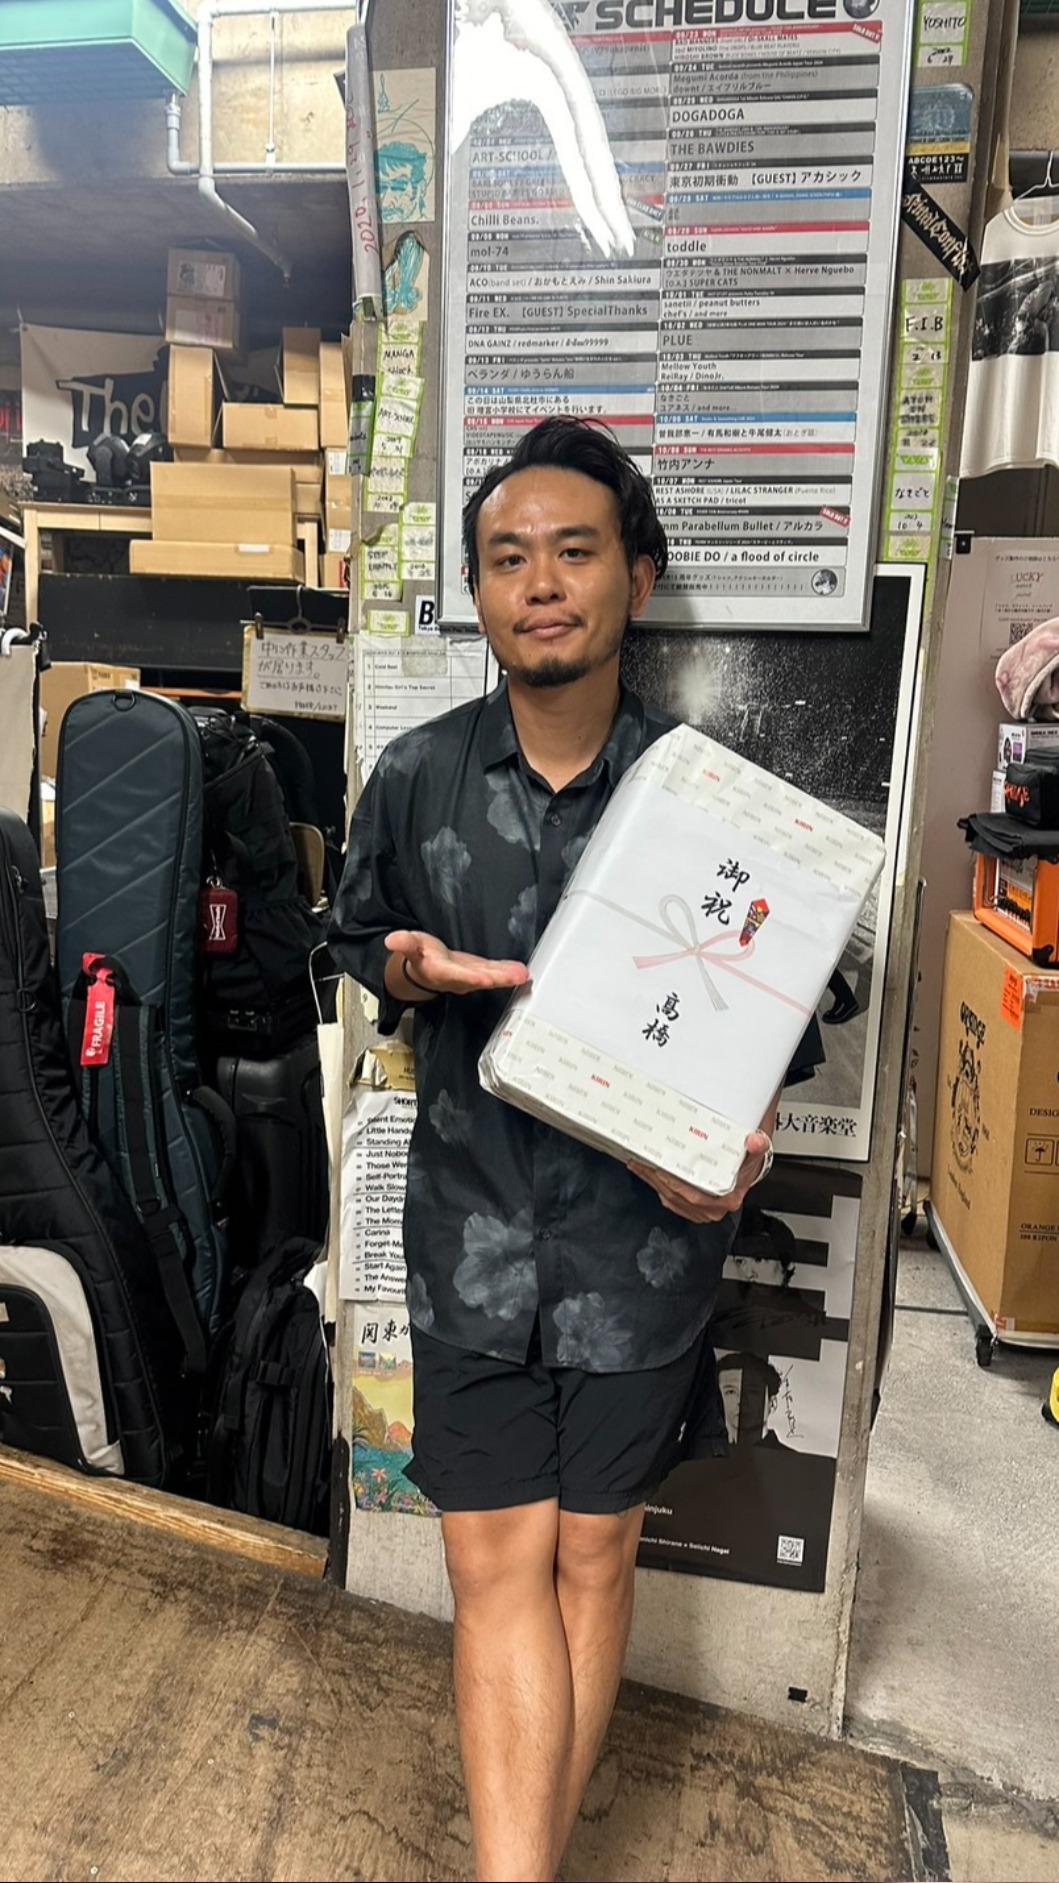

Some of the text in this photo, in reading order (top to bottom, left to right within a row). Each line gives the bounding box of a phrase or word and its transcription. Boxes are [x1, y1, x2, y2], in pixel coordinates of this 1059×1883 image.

[595, 0, 836, 30] SCHEDULE
[923, 15, 967, 31] YOSHITO
[673, 73, 707, 84] Megumi
[709, 71, 739, 81] Acorda
[672, 108, 745, 122] DOGADOGA
[671, 141, 755, 156] THE BAWDIES
[801, 169, 862, 184] アカシック
[471, 214, 539, 226] Chilli Beans.
[470, 246, 509, 258] mol-74
[667, 240, 707, 252] toddle
[740, 266, 782, 276] NONMALT
[794, 265, 820, 275] Herve
[821, 265, 855, 277] Nguebo
[594, 275, 615, 285] Shin
[617, 275, 651, 285] Sakiura
[689, 278, 738, 287] SUPER CATS
[699, 299, 730, 310] peanut
[732, 298, 760, 308] butters
[468, 307, 490, 318] Fire
[493, 306, 510, 318] EX.
[567, 303, 648, 319] SpecialThanks
[906, 316, 943, 332] F.I.B
[468, 340, 484, 349] DNA
[486, 339, 511, 348] GAINZ
[518, 338, 560, 348] redmarker
[663, 335, 693, 346] PLUE
[661, 361, 717, 371] Mellow Youth
[468, 367, 574, 380] ベランダ ゆうらん船
[56, 378, 156, 438] The
[657, 457, 715, 471] 竹内アンナ
[675, 486, 705, 495] ASHORE
[731, 486, 751, 495] LILAC
[754, 486, 794, 495] STRANGER
[674, 496, 702, 505] SKETCH
[704, 496, 719, 505] PAD
[725, 496, 746, 505] tricot
[681, 520, 823, 532] Parabellum Bullet アルカラ
[704, 550, 820, 562] DO a flood of circle
[701, 858, 750, 926] 御祝
[90, 1001, 106, 1048] FRAGILE
[642, 992, 680, 1048] 高橋
[366, 1139, 401, 1148] Standing
[366, 1150, 384, 1158] Just
[366, 1162, 390, 1170] Those
[365, 1184, 385, 1192] Walk
[365, 1206, 380, 1214] The
[364, 1240, 391, 1248] Forget
[364, 1251, 387, 1259] Break
[364, 1262, 384, 1270] Start
[364, 1285, 376, 1293] My
